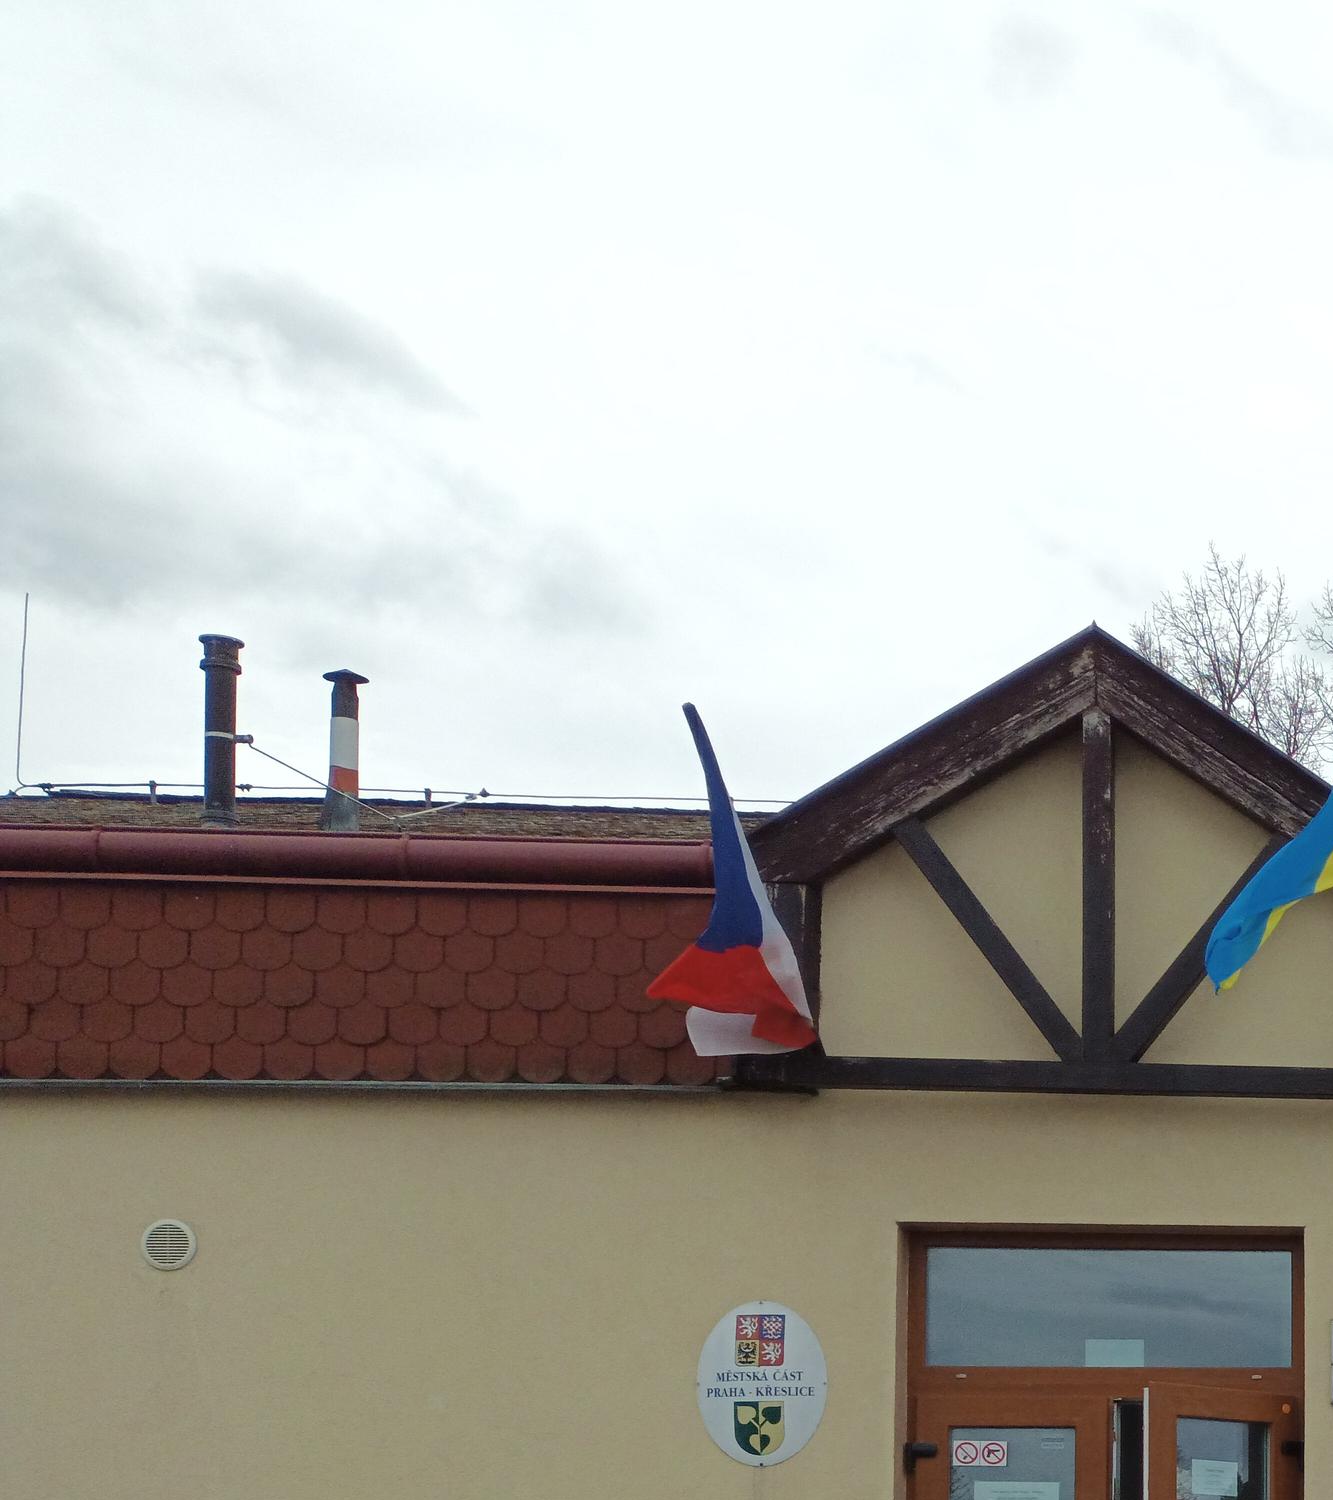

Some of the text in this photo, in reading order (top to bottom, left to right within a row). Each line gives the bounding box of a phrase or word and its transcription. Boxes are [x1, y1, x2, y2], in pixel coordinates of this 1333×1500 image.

[715, 1370, 804, 1382] MĚSTSKÁ ČÁST
[706, 1387, 746, 1398] PRAHA
[755, 1385, 816, 1397] KŘESLICE
